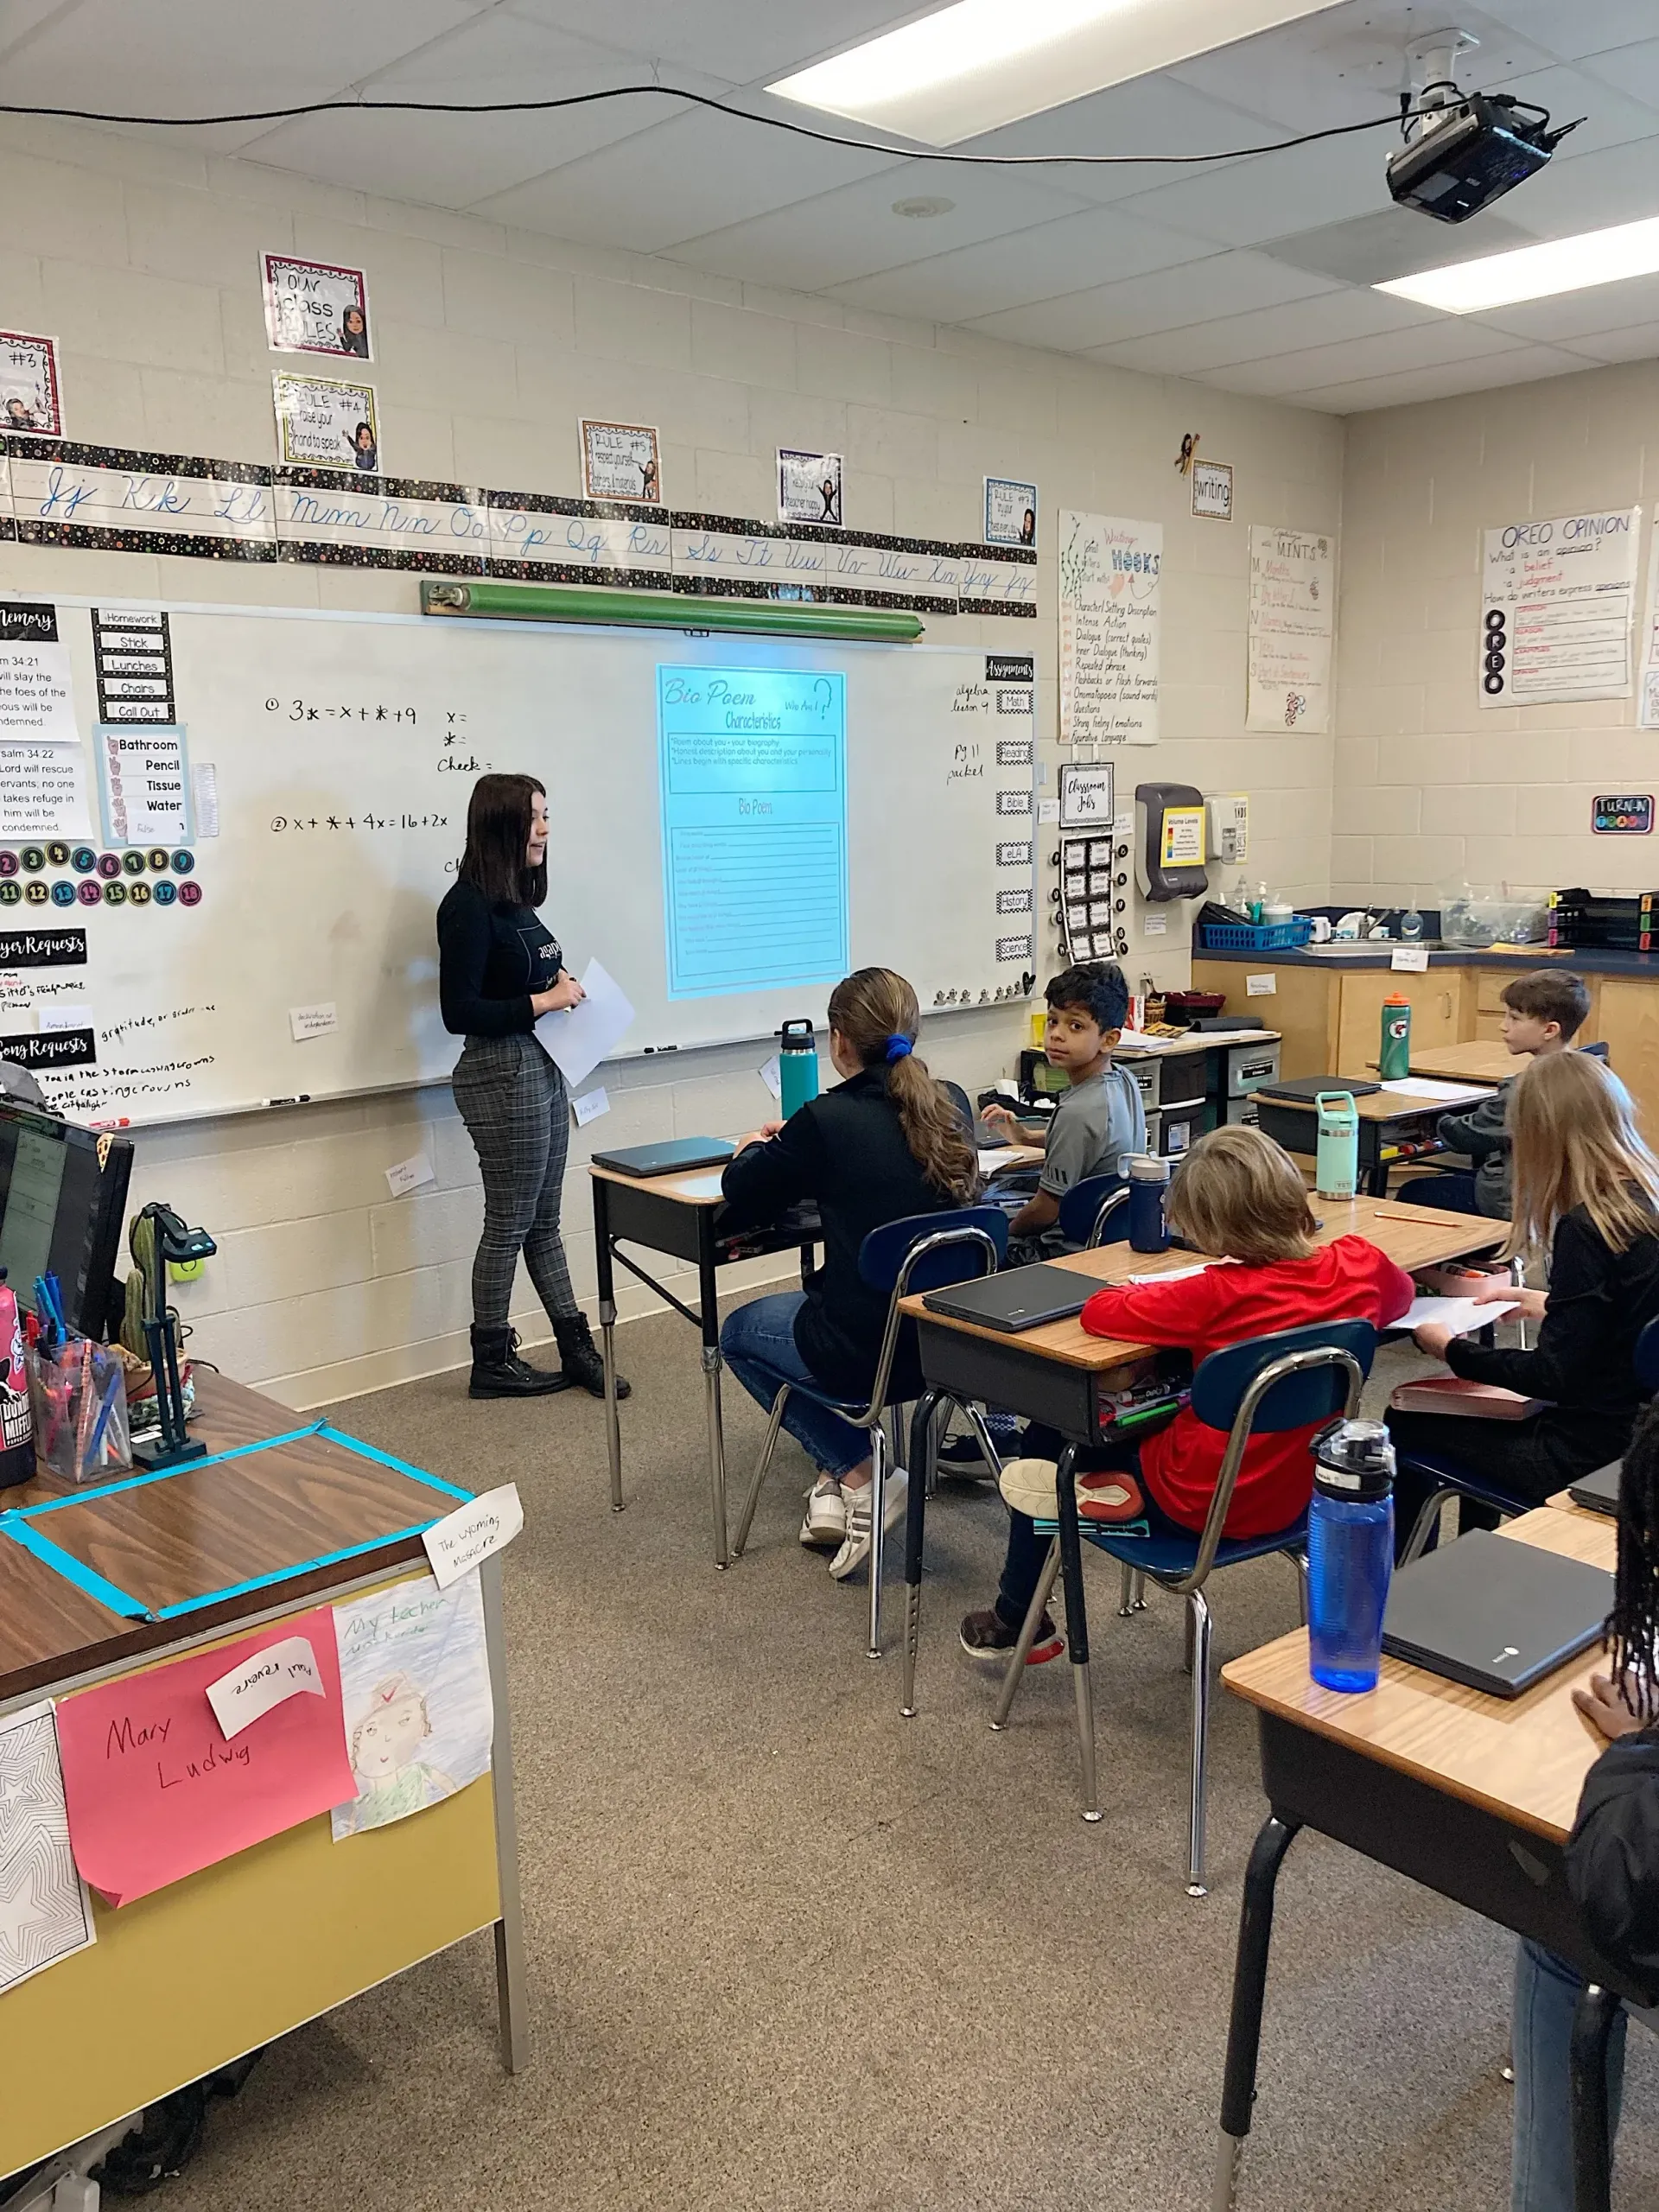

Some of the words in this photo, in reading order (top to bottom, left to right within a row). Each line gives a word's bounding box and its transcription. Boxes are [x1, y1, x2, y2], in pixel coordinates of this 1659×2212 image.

[9, 352, 36, 367] #3
[339, 399, 361, 413] #4
[293, 431, 312, 448] hand
[595, 433, 623, 448] RULE
[630, 439, 646, 452] #5
[995, 489, 1014, 502] RULE
[1196, 475, 1229, 507] writing
[41, 467, 98, 518] Jj
[122, 475, 190, 513] Kk
[213, 487, 266, 524] Ll
[290, 490, 371, 528] Mm
[380, 501, 440, 534] Nn
[450, 507, 485, 538] Oo
[504, 514, 551, 556] Pp
[566, 520, 608, 563] Qq
[627, 525, 667, 556] Rr
[685, 535, 723, 562] Ss
[736, 539, 773, 566] Tt
[785, 543, 823, 570] Uu
[837, 547, 868, 573] Vv
[879, 552, 918, 580] Ww
[964, 560, 999, 596] Yy
[1005, 565, 1034, 599] Zz
[1502, 523, 1554, 549] OREO
[1562, 516, 1630, 539] OPINION
[1111, 549, 1160, 575] HOOKS
[1490, 549, 1515, 563] What
[1537, 549, 1550, 557] an
[1252, 557, 1260, 573] M
[1523, 557, 1554, 572] belief
[1516, 570, 1563, 589] judgment
[1484, 592, 1504, 604] How
[1507, 593, 1518, 601] do
[1522, 588, 1555, 601] writers
[1558, 584, 1592, 597] express
[106, 612, 157, 624] Homework
[1128, 603, 1157, 619] Description
[1251, 610, 1259, 625] N
[1076, 613, 1099, 626] Intense
[1103, 615, 1127, 628] Action
[120, 637, 148, 648] Stick
[1076, 628, 1101, 644] Dialogue
[1105, 630, 1129, 644] (correct
[1132, 632, 1152, 645] quotes)
[1076, 642, 1090, 656] Inner
[1093, 644, 1117, 660] Dialogue
[1120, 645, 1147, 661] (thinking)
[12, 657, 38, 666] 34:21
[111, 659, 157, 671] Lunches
[986, 659, 1033, 678] Assignments
[1076, 657, 1103, 672] Repeated
[1105, 659, 1126, 674] phrase
[14, 673, 33, 683] slay
[36, 672, 52, 682] the
[16, 687, 35, 696] foes
[39, 687, 48, 696] of
[51, 687, 66, 697] the
[121, 683, 155, 693] Chairs
[665, 678, 702, 704] Bio
[708, 680, 756, 705] Poem
[957, 683, 990, 702] algebra
[1074, 686, 1116, 702] Onomatopoeia
[1119, 687, 1141, 702] (sound
[22, 702, 37, 712] will
[41, 702, 53, 712] be
[785, 701, 799, 710] Who
[801, 701, 812, 710] Am
[950, 699, 978, 712] lesson
[1006, 696, 1025, 707] Math
[1074, 701, 1100, 714] Questions
[118, 706, 137, 717] Call
[140, 707, 160, 717] Out
[726, 711, 781, 730] Characteristics
[1073, 715, 1090, 731] Strong
[1116, 716, 1142, 728] emotions
[119, 739, 178, 751] Bathroom
[693, 738, 713, 747] about
[715, 740, 726, 749] you
[732, 740, 746, 749] your
[1102, 730, 1127, 745] Language
[1, 748, 24, 759] salm
[28, 748, 54, 759] 34:22
[699, 747, 735, 758] description
[737, 747, 756, 756] about
[758, 749, 768, 758] you
[784, 749, 797, 758] your
[1001, 747, 1029, 761] Reading
[24, 765, 39, 773] will
[146, 760, 180, 771] Pencil
[437, 756, 480, 772] Check
[693, 757, 712, 767] begin
[714, 757, 727, 766] with
[1, 779, 39, 788] ervants;
[147, 780, 181, 791] Tissue
[1068, 779, 1106, 794] Classroom
[3, 795, 29, 804] takes
[33, 794, 62, 804] refuge
[67, 794, 74, 803] in
[147, 800, 182, 811] Water
[739, 798, 751, 815] Bio
[753, 798, 772, 815] Poem
[1007, 797, 1024, 808] Bible
[1077, 794, 1096, 813] Jobs
[4, 809, 22, 817] him
[25, 809, 40, 817] will
[43, 809, 54, 817] be
[3, 823, 61, 832] condemned.
[29, 852, 38, 866] 3
[155, 854, 163, 867] 8
[179, 855, 187, 868] 9
[2, 886, 17, 899] 11
[29, 887, 45, 900] 12
[56, 886, 73, 899] 13
[82, 885, 99, 899] 14
[109, 887, 124, 900] 15
[133, 887, 148, 900] 16
[158, 886, 173, 899] 17
[182, 887, 198, 900] 18
[1002, 896, 1028, 908] History
[26, 936, 84, 956] Requests
[1001, 942, 1028, 956] Science
[30, 1037, 87, 1058] Requests
[438, 1539, 456, 1552] The
[344, 1611, 382, 1638] My
[106, 1717, 171, 1760] Mary
[158, 1743, 251, 1789] Ludwig
